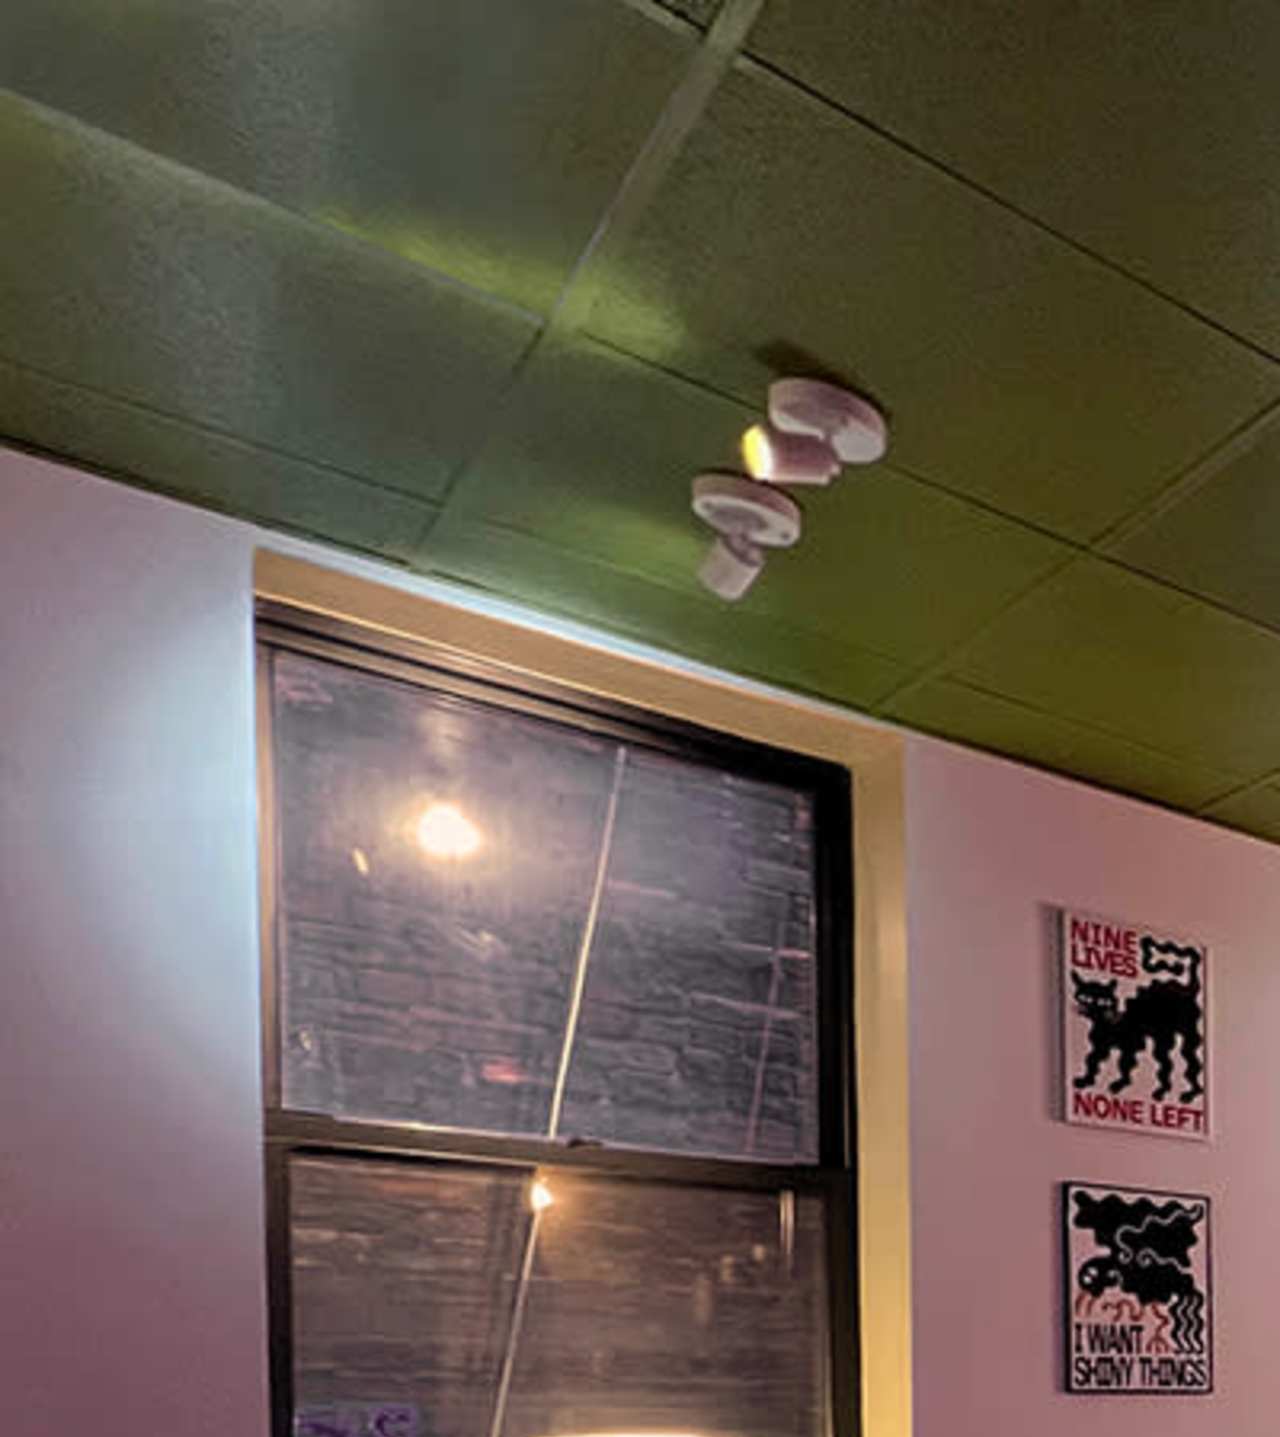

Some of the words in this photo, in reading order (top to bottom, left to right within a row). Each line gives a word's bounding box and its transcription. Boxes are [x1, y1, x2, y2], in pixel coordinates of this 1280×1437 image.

[1071, 920, 1137, 953] NINE
[1071, 944, 1138, 977] LIVES
[1073, 1094, 1143, 1124] NONE
[1150, 1104, 1205, 1132] LEFT
[1075, 1324, 1082, 1353] I
[1087, 1324, 1143, 1354] WANT
[1075, 1357, 1133, 1386] SHINY
[1139, 1359, 1206, 1386] THINGS
